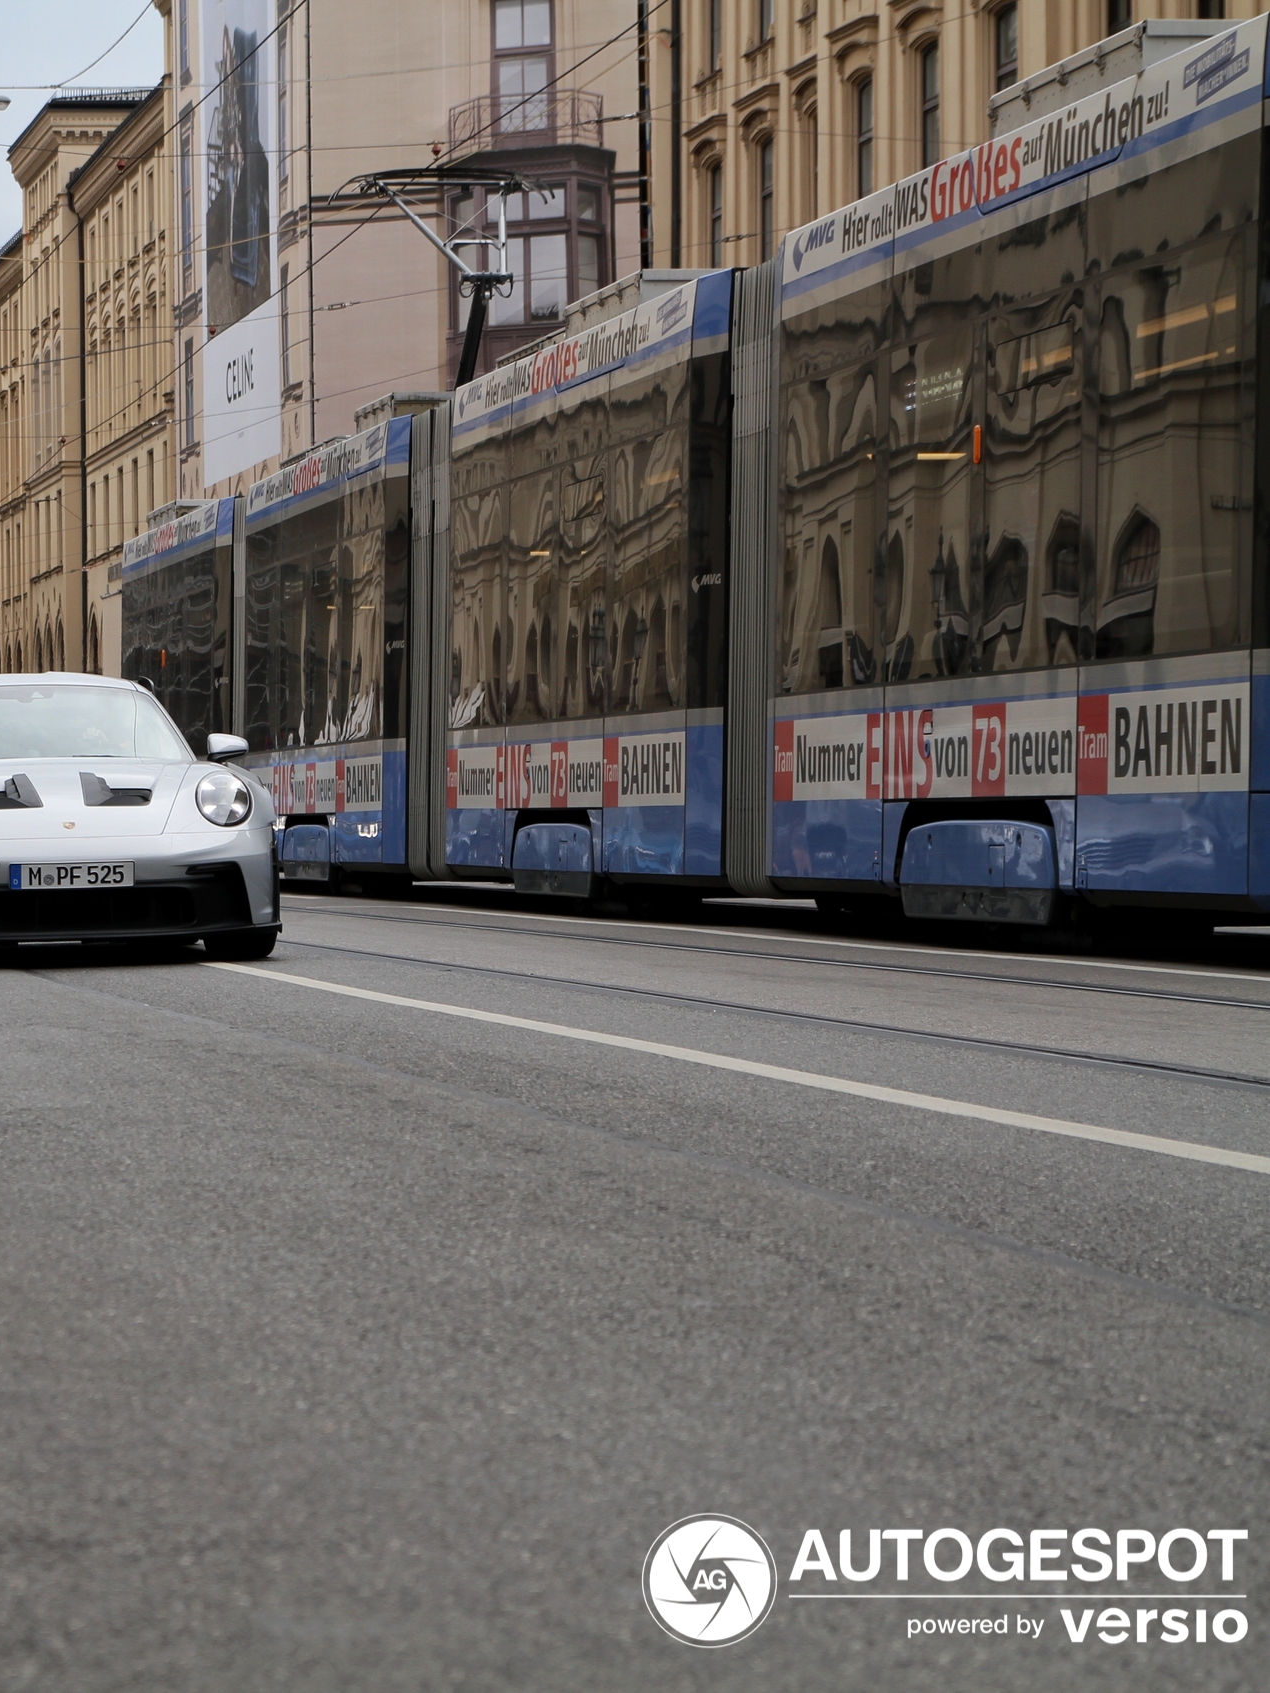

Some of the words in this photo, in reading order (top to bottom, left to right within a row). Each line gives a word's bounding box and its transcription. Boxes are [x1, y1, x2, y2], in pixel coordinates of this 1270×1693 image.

[842, 206, 870, 253] Hier
[870, 203, 894, 241] rollt
[896, 177, 929, 231] WAS
[930, 137, 1022, 223] Großes
[1022, 123, 1046, 166] auf
[1043, 92, 1144, 178] München
[1146, 80, 1170, 125] zu!
[805, 219, 836, 252] MVG
[226, 347, 255, 404] CELINE
[484, 375, 501, 409] Hier
[513, 361, 531, 397] WAS
[531, 340, 579, 394] Großes
[578, 340, 590, 362] auf
[588, 319, 639, 371] München
[638, 317, 651, 345] zu!
[465, 383, 483, 406] MVG
[325, 442, 355, 480] München
[700, 573, 722, 585] MVG
[775, 746, 793, 773] Tram
[796, 735, 864, 783] Nummer
[866, 709, 934, 799] EINS
[934, 735, 968, 778] von
[975, 716, 1002, 783] 73
[1008, 729, 1073, 775] neuen
[1078, 726, 1108, 759] Tram
[1114, 698, 1242, 778] BAHNEN
[273, 765, 295, 814] EINS
[306, 770, 315, 806] 73
[346, 763, 381, 803] BAHNEN
[447, 767, 458, 788] Tram
[458, 759, 495, 796] Nummer
[496, 744, 531, 808] EINS
[531, 763, 549, 794] von
[552, 751, 566, 798] 73
[569, 760, 601, 793] neuen
[604, 759, 618, 782] Tram
[621, 742, 682, 796] BAHNEN
[29, 867, 41, 885] M
[56, 866, 82, 885] PF
[87, 865, 124, 885] 525
